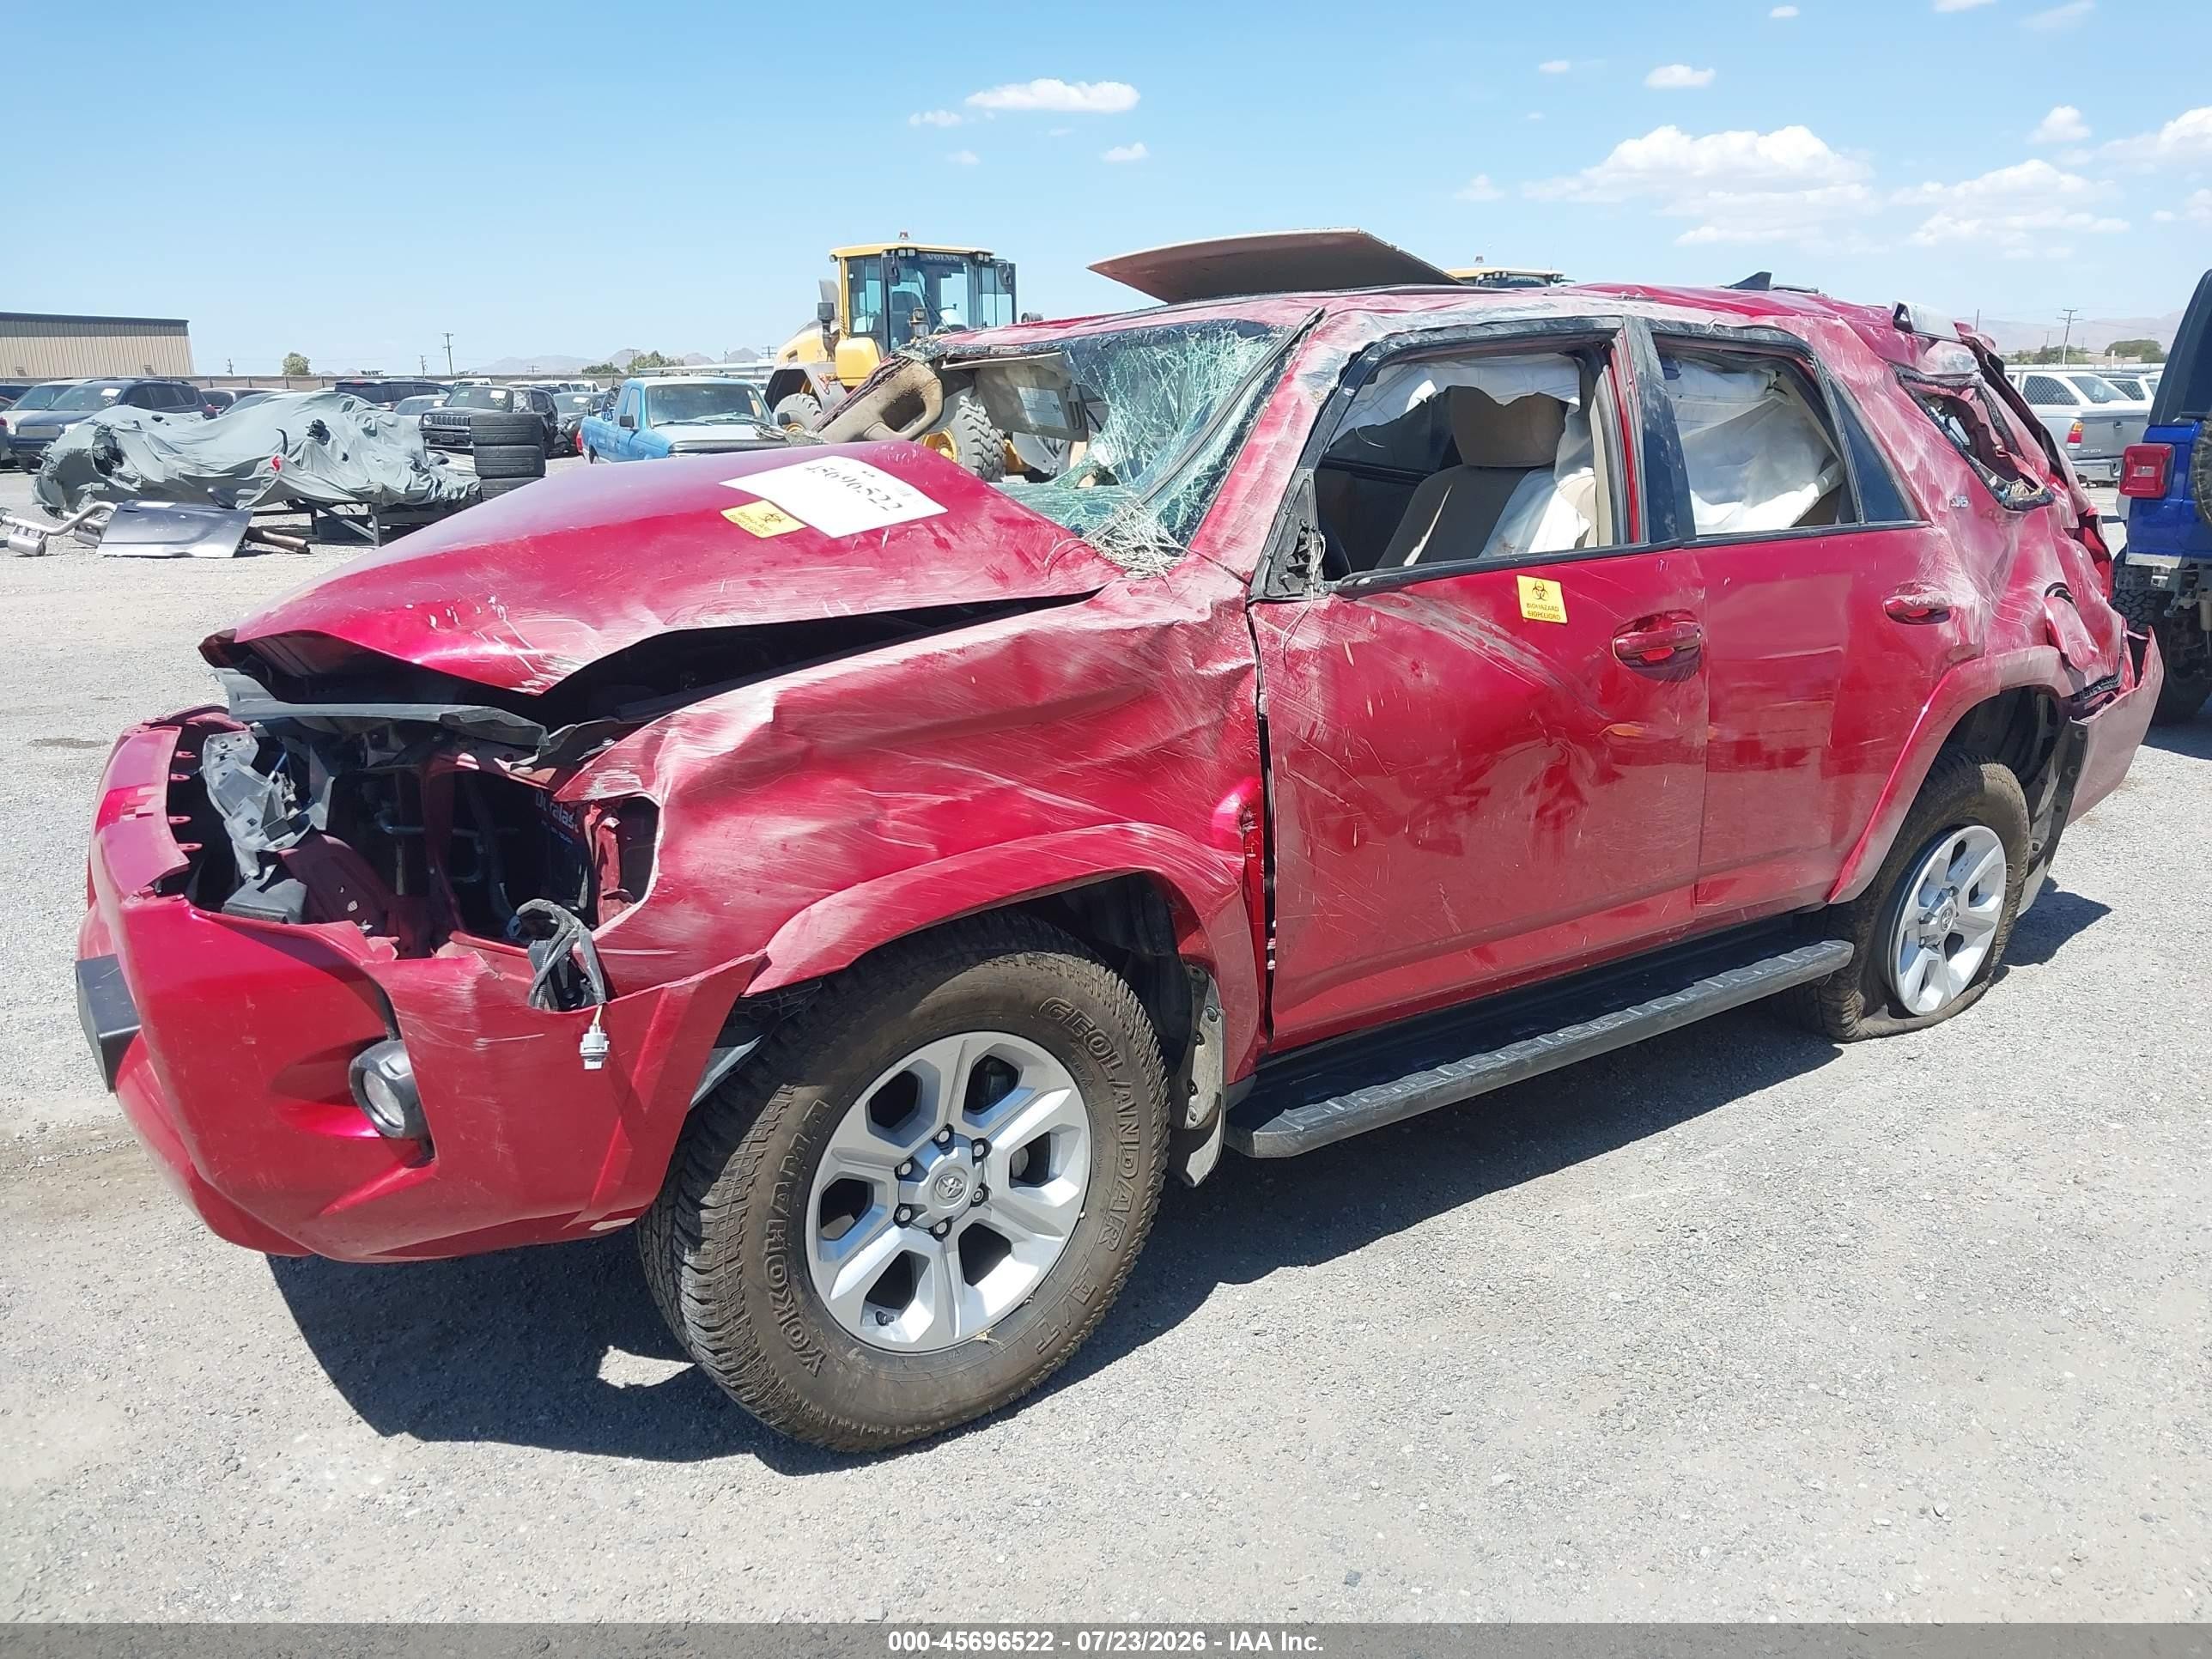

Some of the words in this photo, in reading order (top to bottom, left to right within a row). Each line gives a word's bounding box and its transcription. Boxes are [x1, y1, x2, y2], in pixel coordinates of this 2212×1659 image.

[927, 253, 960, 262] VOLVO
[1526, 602, 1559, 612] BIOHAZARD
[1527, 611, 1561, 621] BIOPELIGRO
[1039, 997, 1140, 1252] GEOLANDAR
[763, 1098, 831, 1377] YOKOHAMA
